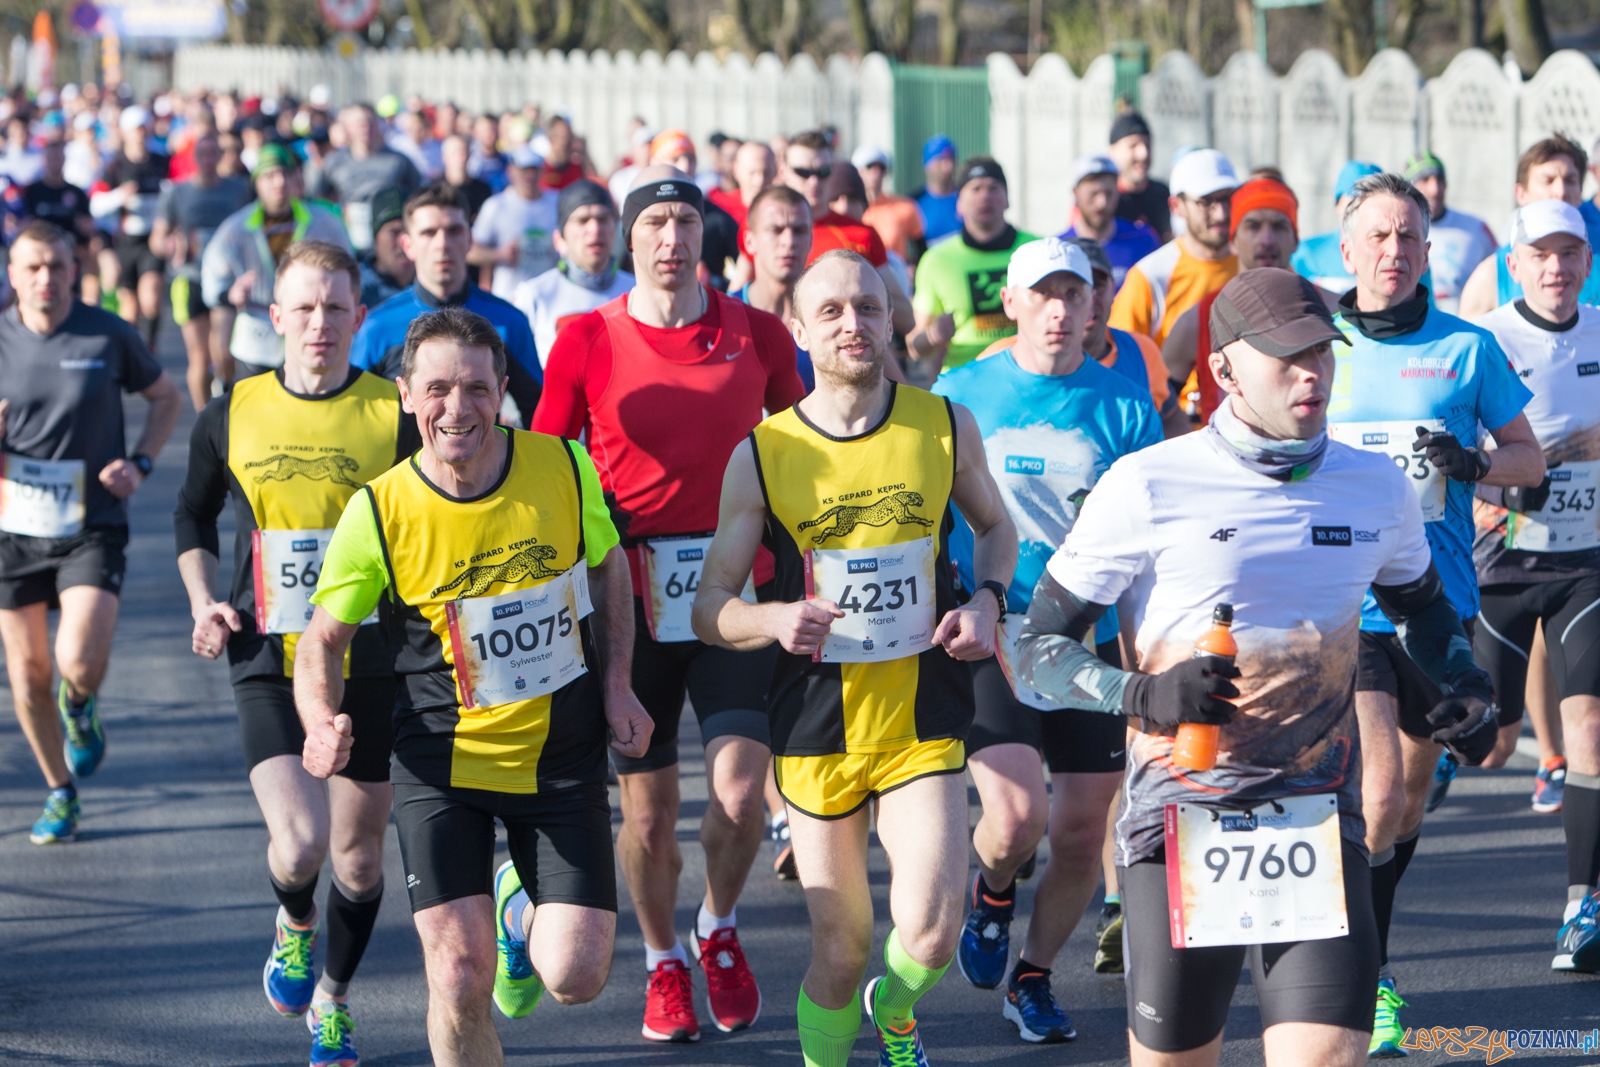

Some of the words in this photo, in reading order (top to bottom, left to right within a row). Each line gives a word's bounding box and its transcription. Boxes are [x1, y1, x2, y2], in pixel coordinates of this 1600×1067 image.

[1401, 368, 1436, 379] MARATON
[1438, 368, 1457, 379] TEAM
[1373, 434, 1388, 442] PKO
[1008, 459, 1020, 469] 16.
[1021, 460, 1043, 471] PKO
[13, 477, 73, 504] 10717
[838, 489, 873, 502] GEPARD
[877, 483, 906, 495] KĘPNO
[1209, 528, 1238, 542] 4F
[1316, 530, 1329, 541] 10.
[1329, 531, 1350, 541] PKO
[302, 541, 317, 549] PKO
[454, 559, 466, 569] KS
[470, 547, 504, 564] GEPARD
[508, 537, 538, 551] KĘPNO
[860, 561, 876, 569] PKO
[281, 561, 324, 589] 56
[838, 575, 918, 614] 4231
[494, 608, 505, 616] 10.
[505, 604, 520, 614] PKO
[867, 615, 897, 626] Marek
[470, 605, 573, 661] 10075
[510, 651, 554, 669] Sylwester
[1236, 816, 1256, 828] PKO
[1204, 841, 1317, 883] 9760
[1249, 886, 1280, 898] Karol
